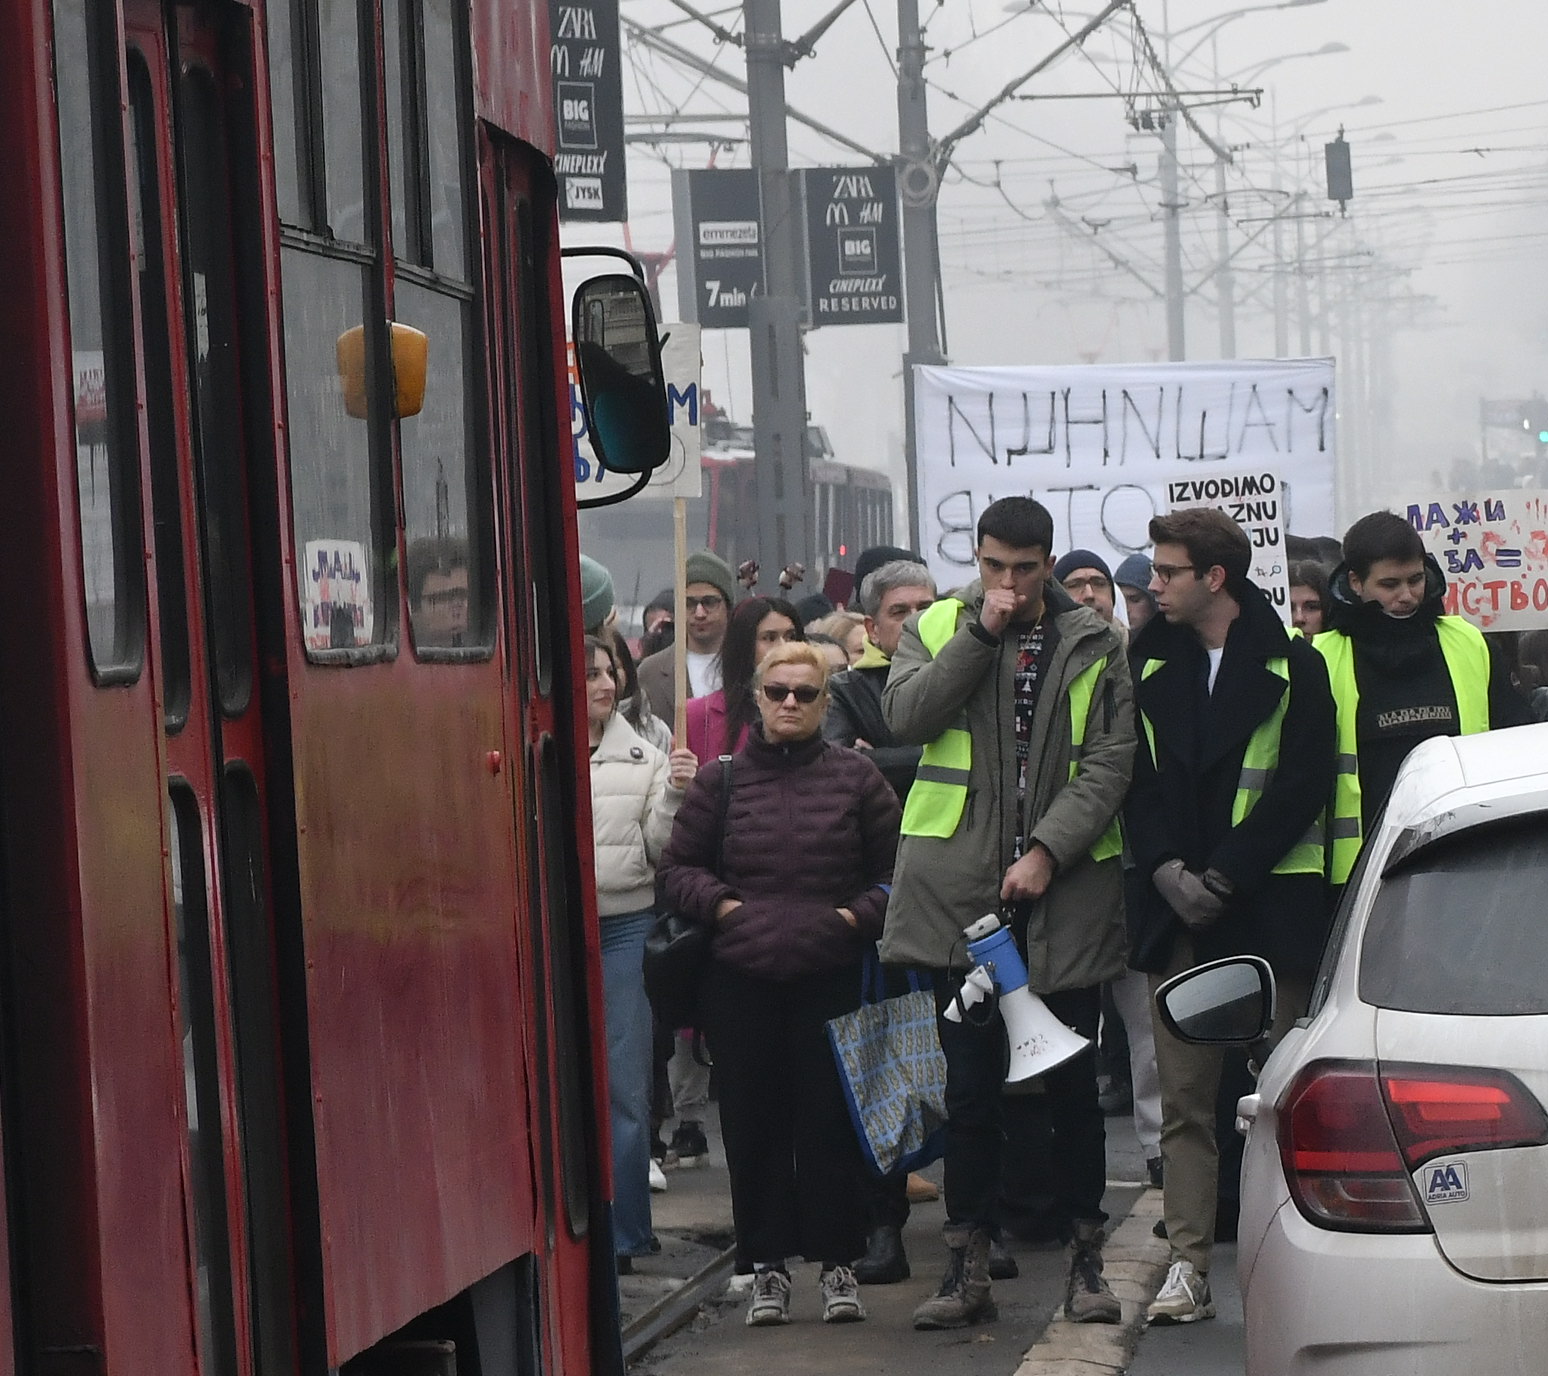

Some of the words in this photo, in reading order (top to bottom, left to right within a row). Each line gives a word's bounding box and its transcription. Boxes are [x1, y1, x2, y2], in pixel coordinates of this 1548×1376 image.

[557, 6, 597, 40] ZARA
[563, 100, 590, 121] BIG
[574, 185, 601, 200] JYSK
[844, 239, 872, 255] BIG
[828, 274, 887, 294] CINEPLEXX
[819, 296, 897, 312] RESERVED
[1169, 473, 1276, 503] IZVODIMO
